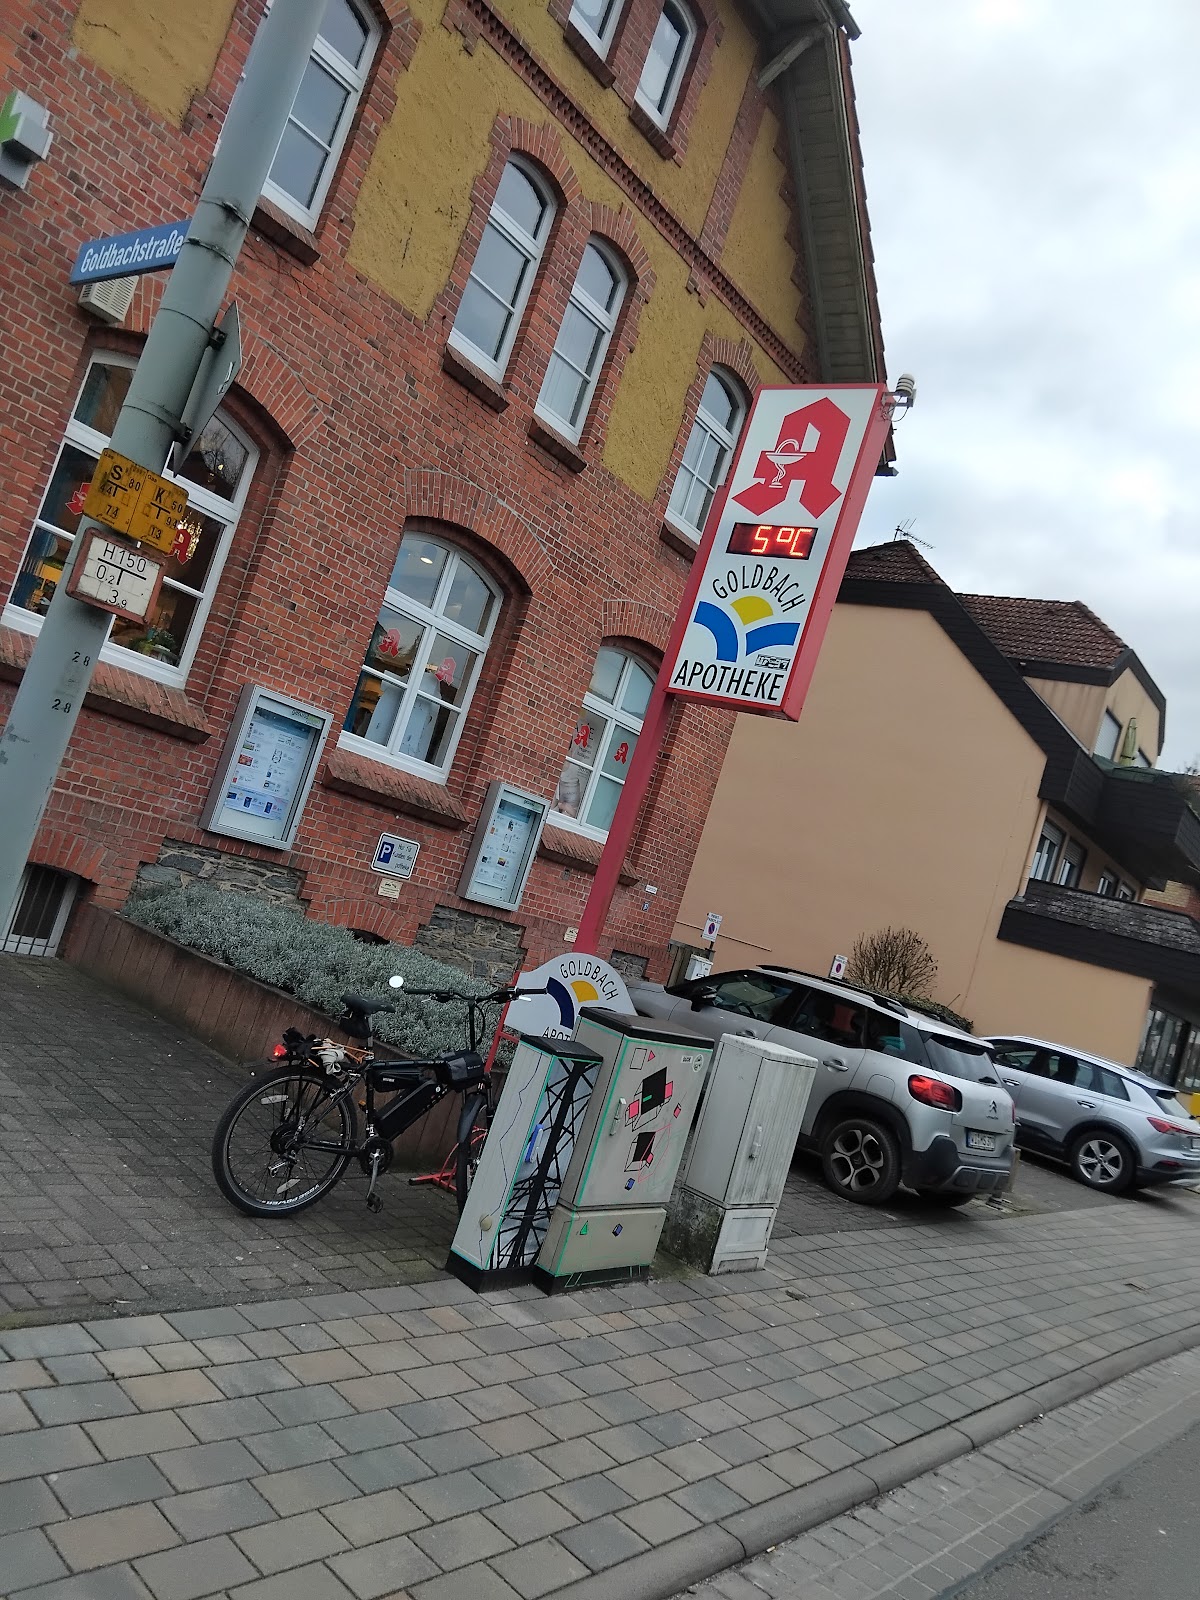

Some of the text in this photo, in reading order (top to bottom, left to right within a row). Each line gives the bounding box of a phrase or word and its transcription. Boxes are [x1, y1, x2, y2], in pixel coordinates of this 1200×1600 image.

[80, 229, 184, 273] Goldbachstraße
[110, 464, 123, 481] S
[171, 501, 183, 514] 50
[712, 563, 806, 613] GOLDBACH
[673, 659, 784, 701] APOTHEKE
[560, 959, 619, 1001] GOLDBACH
